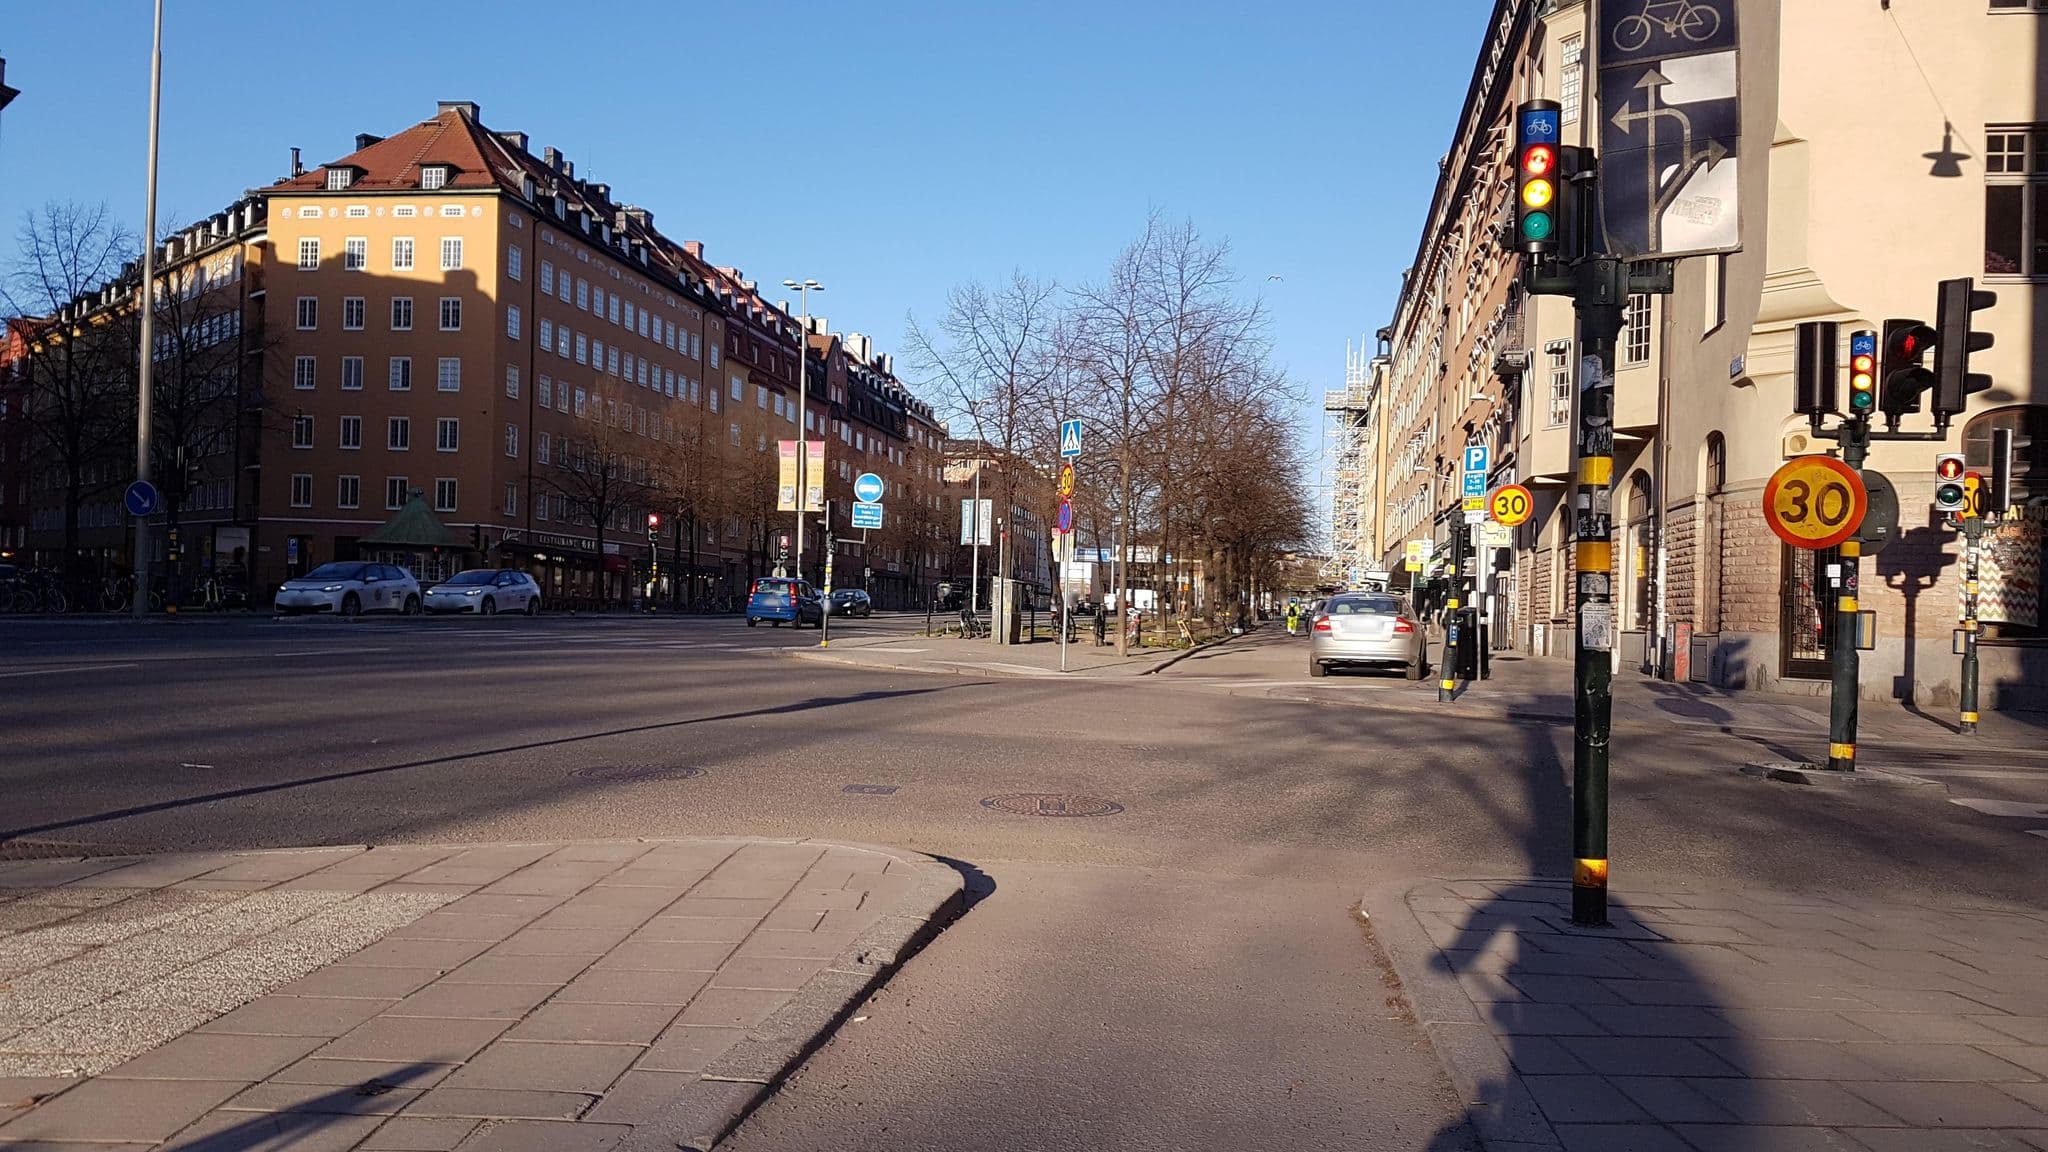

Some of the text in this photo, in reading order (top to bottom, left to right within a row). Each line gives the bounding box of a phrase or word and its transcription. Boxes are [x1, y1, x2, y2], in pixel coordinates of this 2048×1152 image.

[1470, 449, 1484, 470] P
[1062, 472, 1072, 490] 30
[1497, 495, 1526, 516] 30
[1780, 479, 1850, 527] 30
